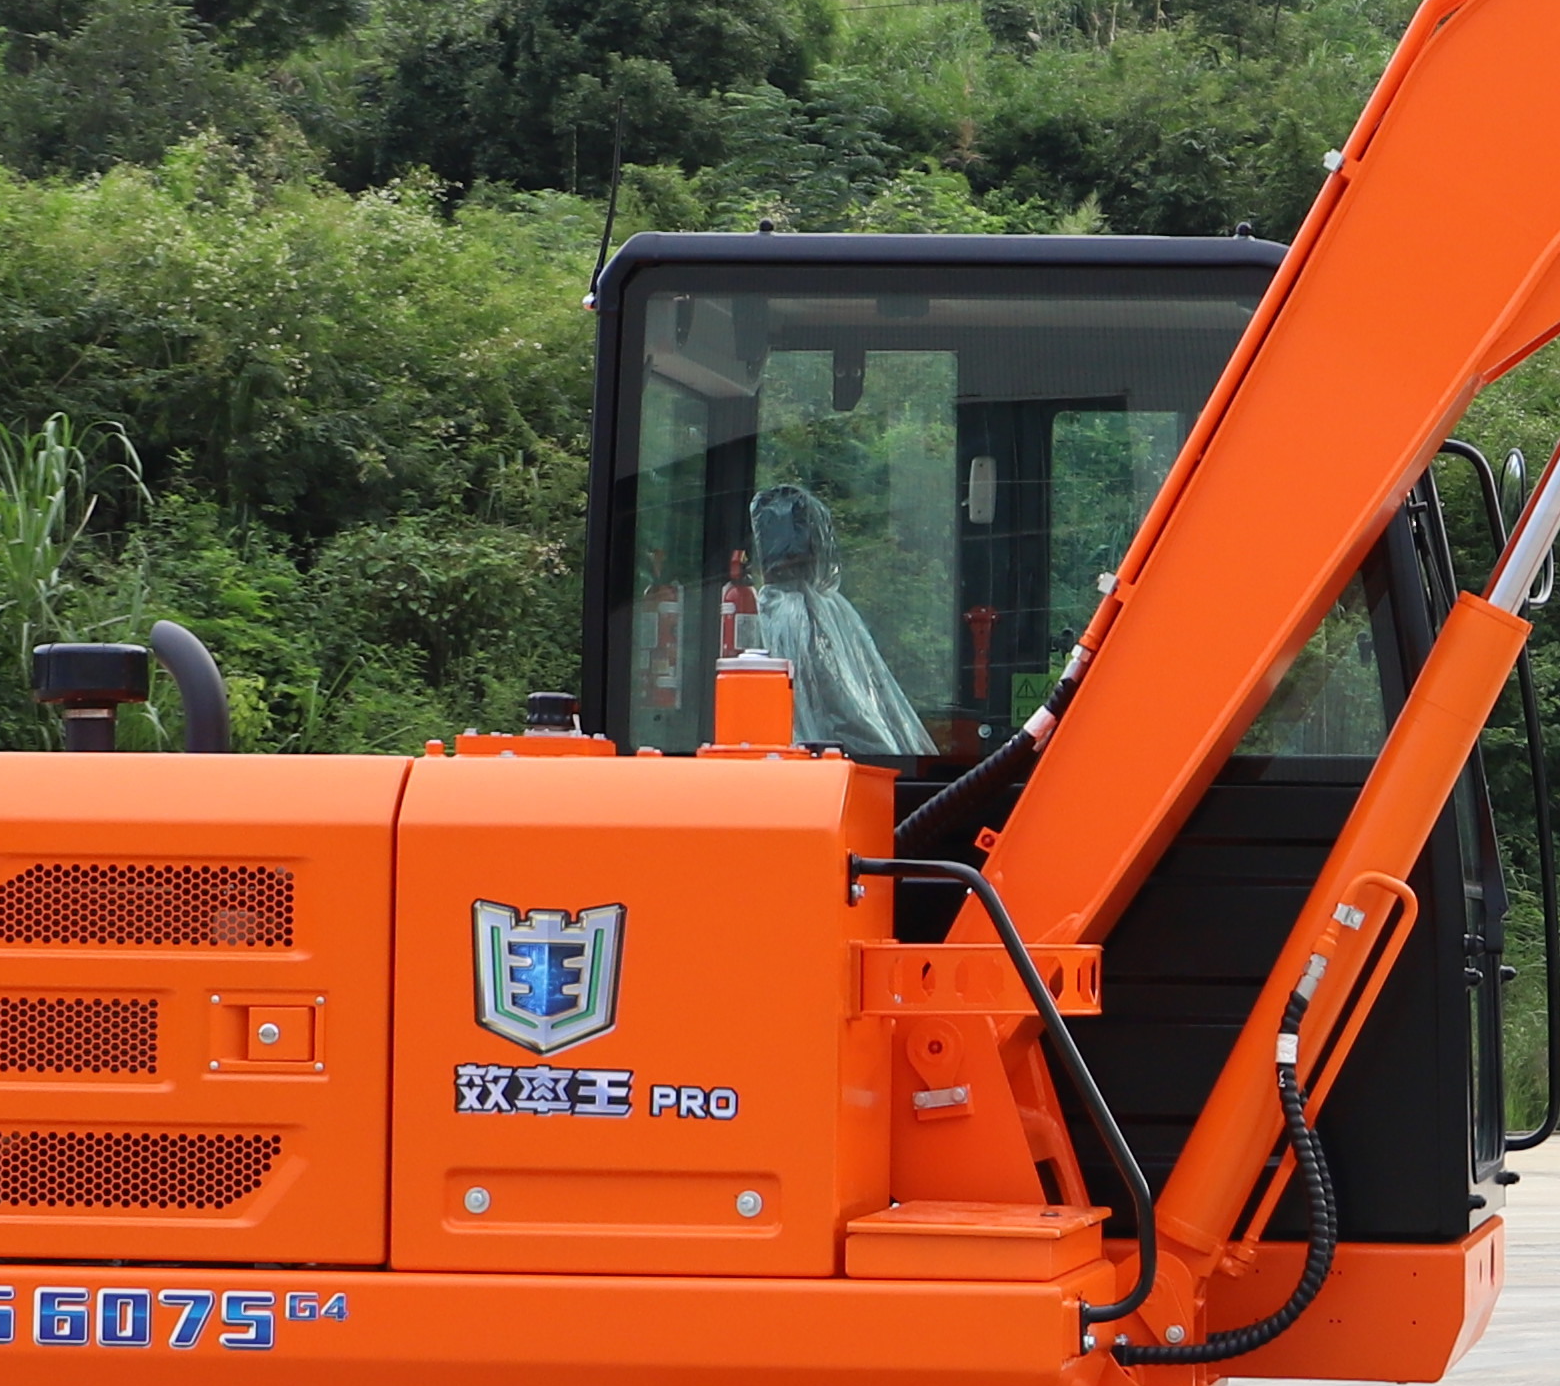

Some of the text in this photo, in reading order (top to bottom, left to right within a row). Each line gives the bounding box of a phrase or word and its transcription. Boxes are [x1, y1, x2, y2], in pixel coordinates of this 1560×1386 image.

[455, 1063, 738, 1120] 效率王 PRO
[33, 1286, 275, 1349] 6075
[285, 1291, 348, 1321] G4
